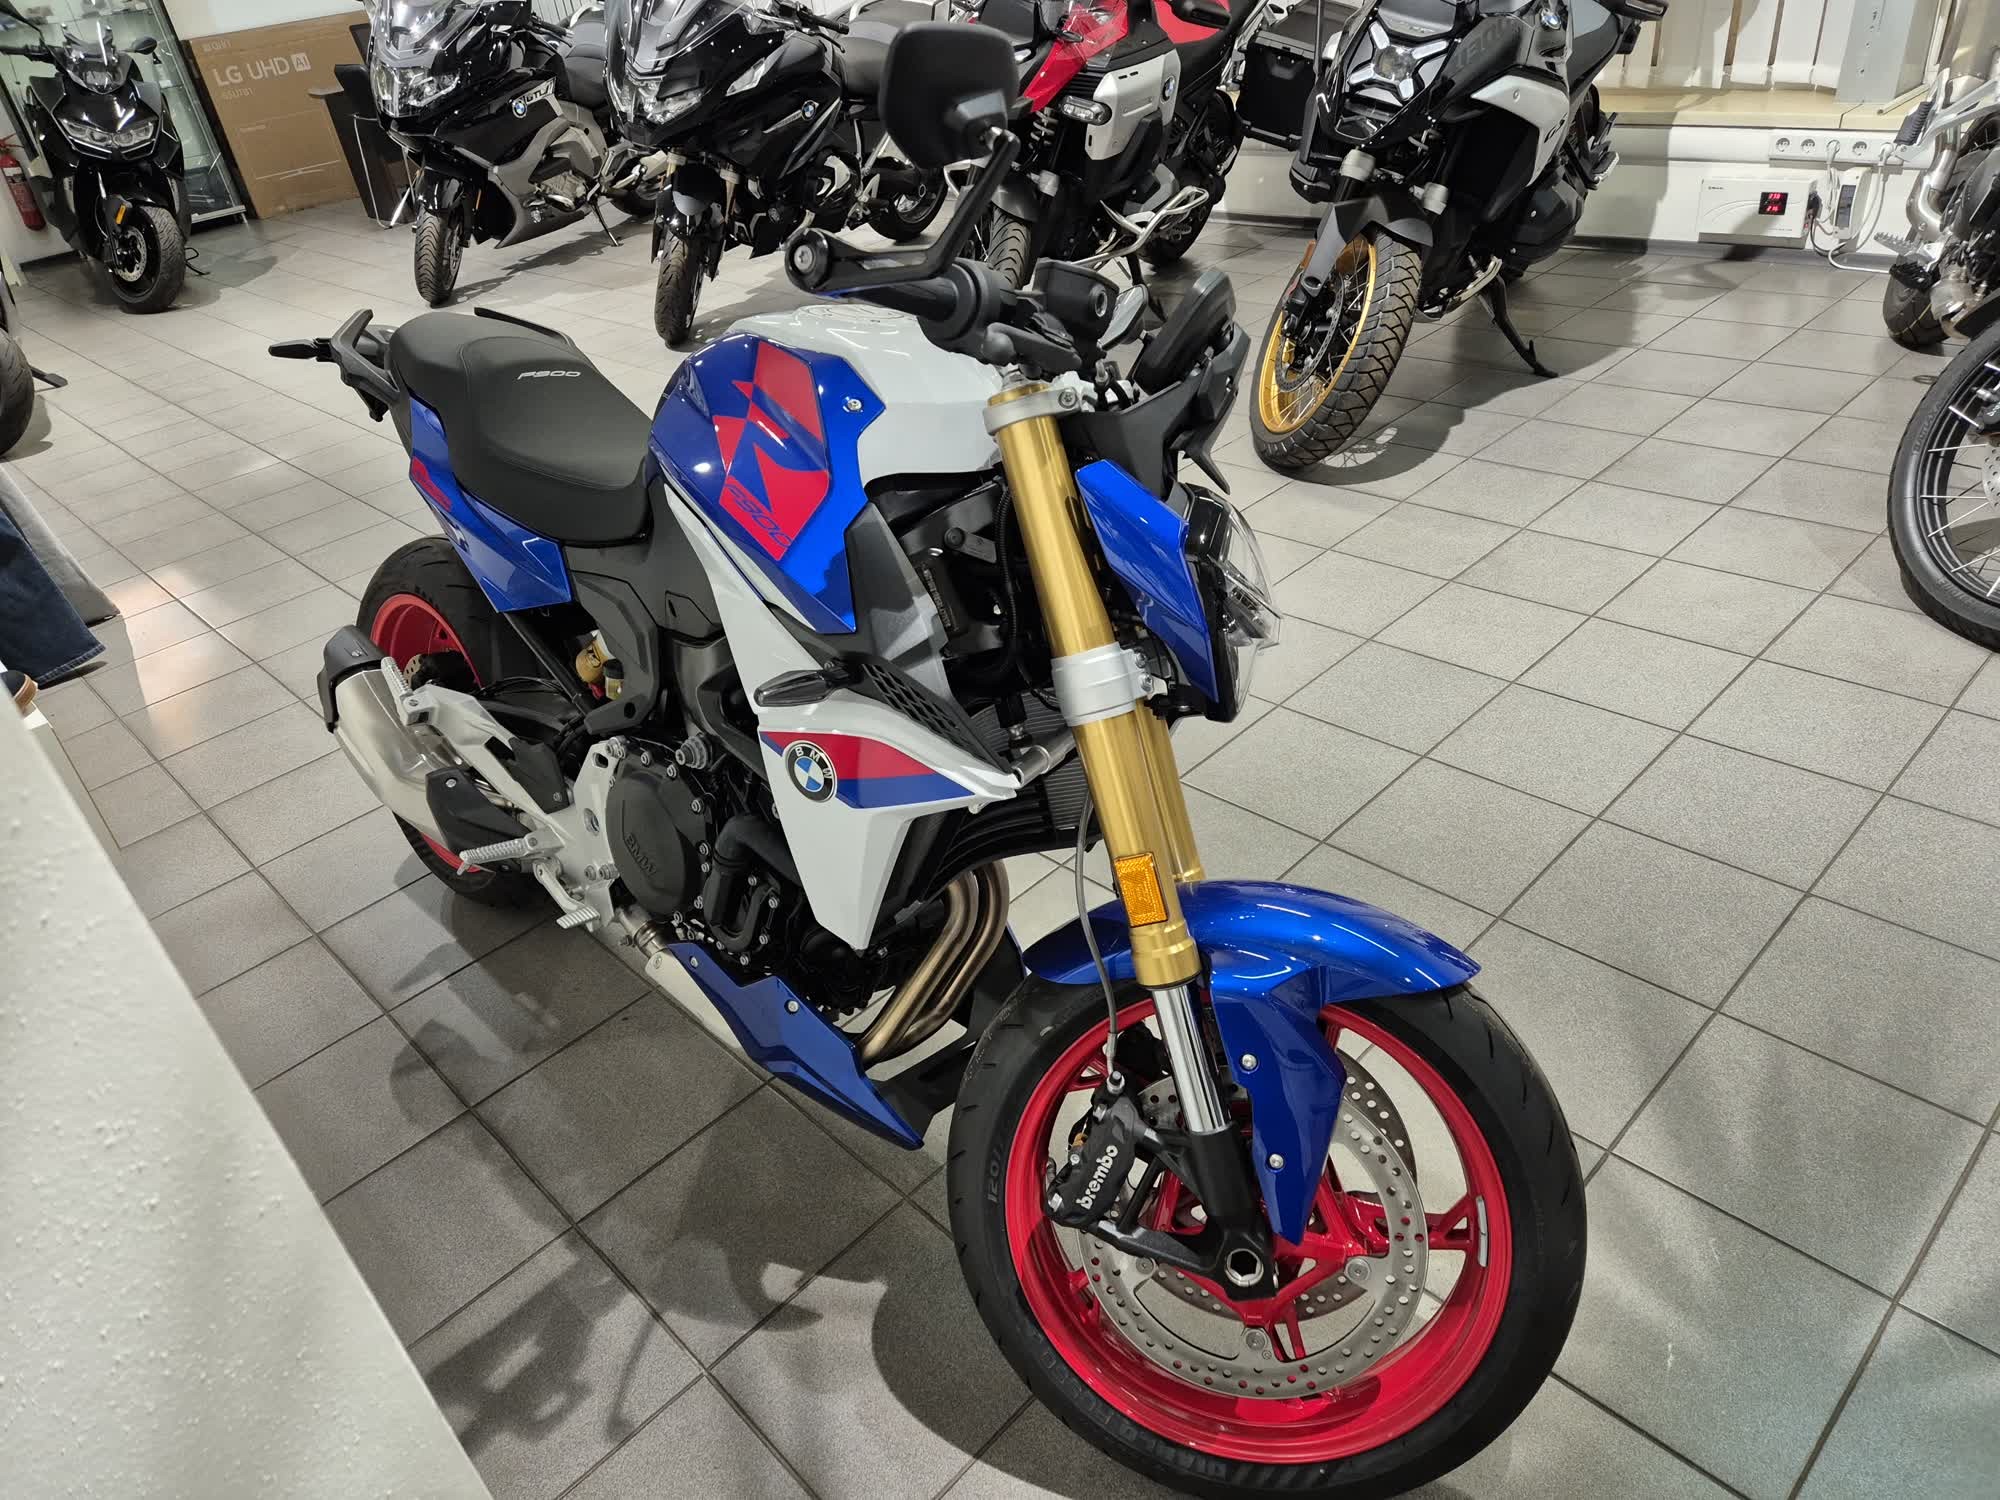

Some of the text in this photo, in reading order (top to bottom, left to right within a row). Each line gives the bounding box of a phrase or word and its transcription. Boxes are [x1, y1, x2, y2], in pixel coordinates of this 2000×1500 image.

[212, 65, 244, 87] LG
[246, 56, 291, 80] UHD
[517, 370, 581, 380] F900
[724, 484, 793, 548] F900
[794, 746, 833, 779] BMW
[625, 832, 657, 877] BMW
[1075, 1144, 1119, 1210] brembo
